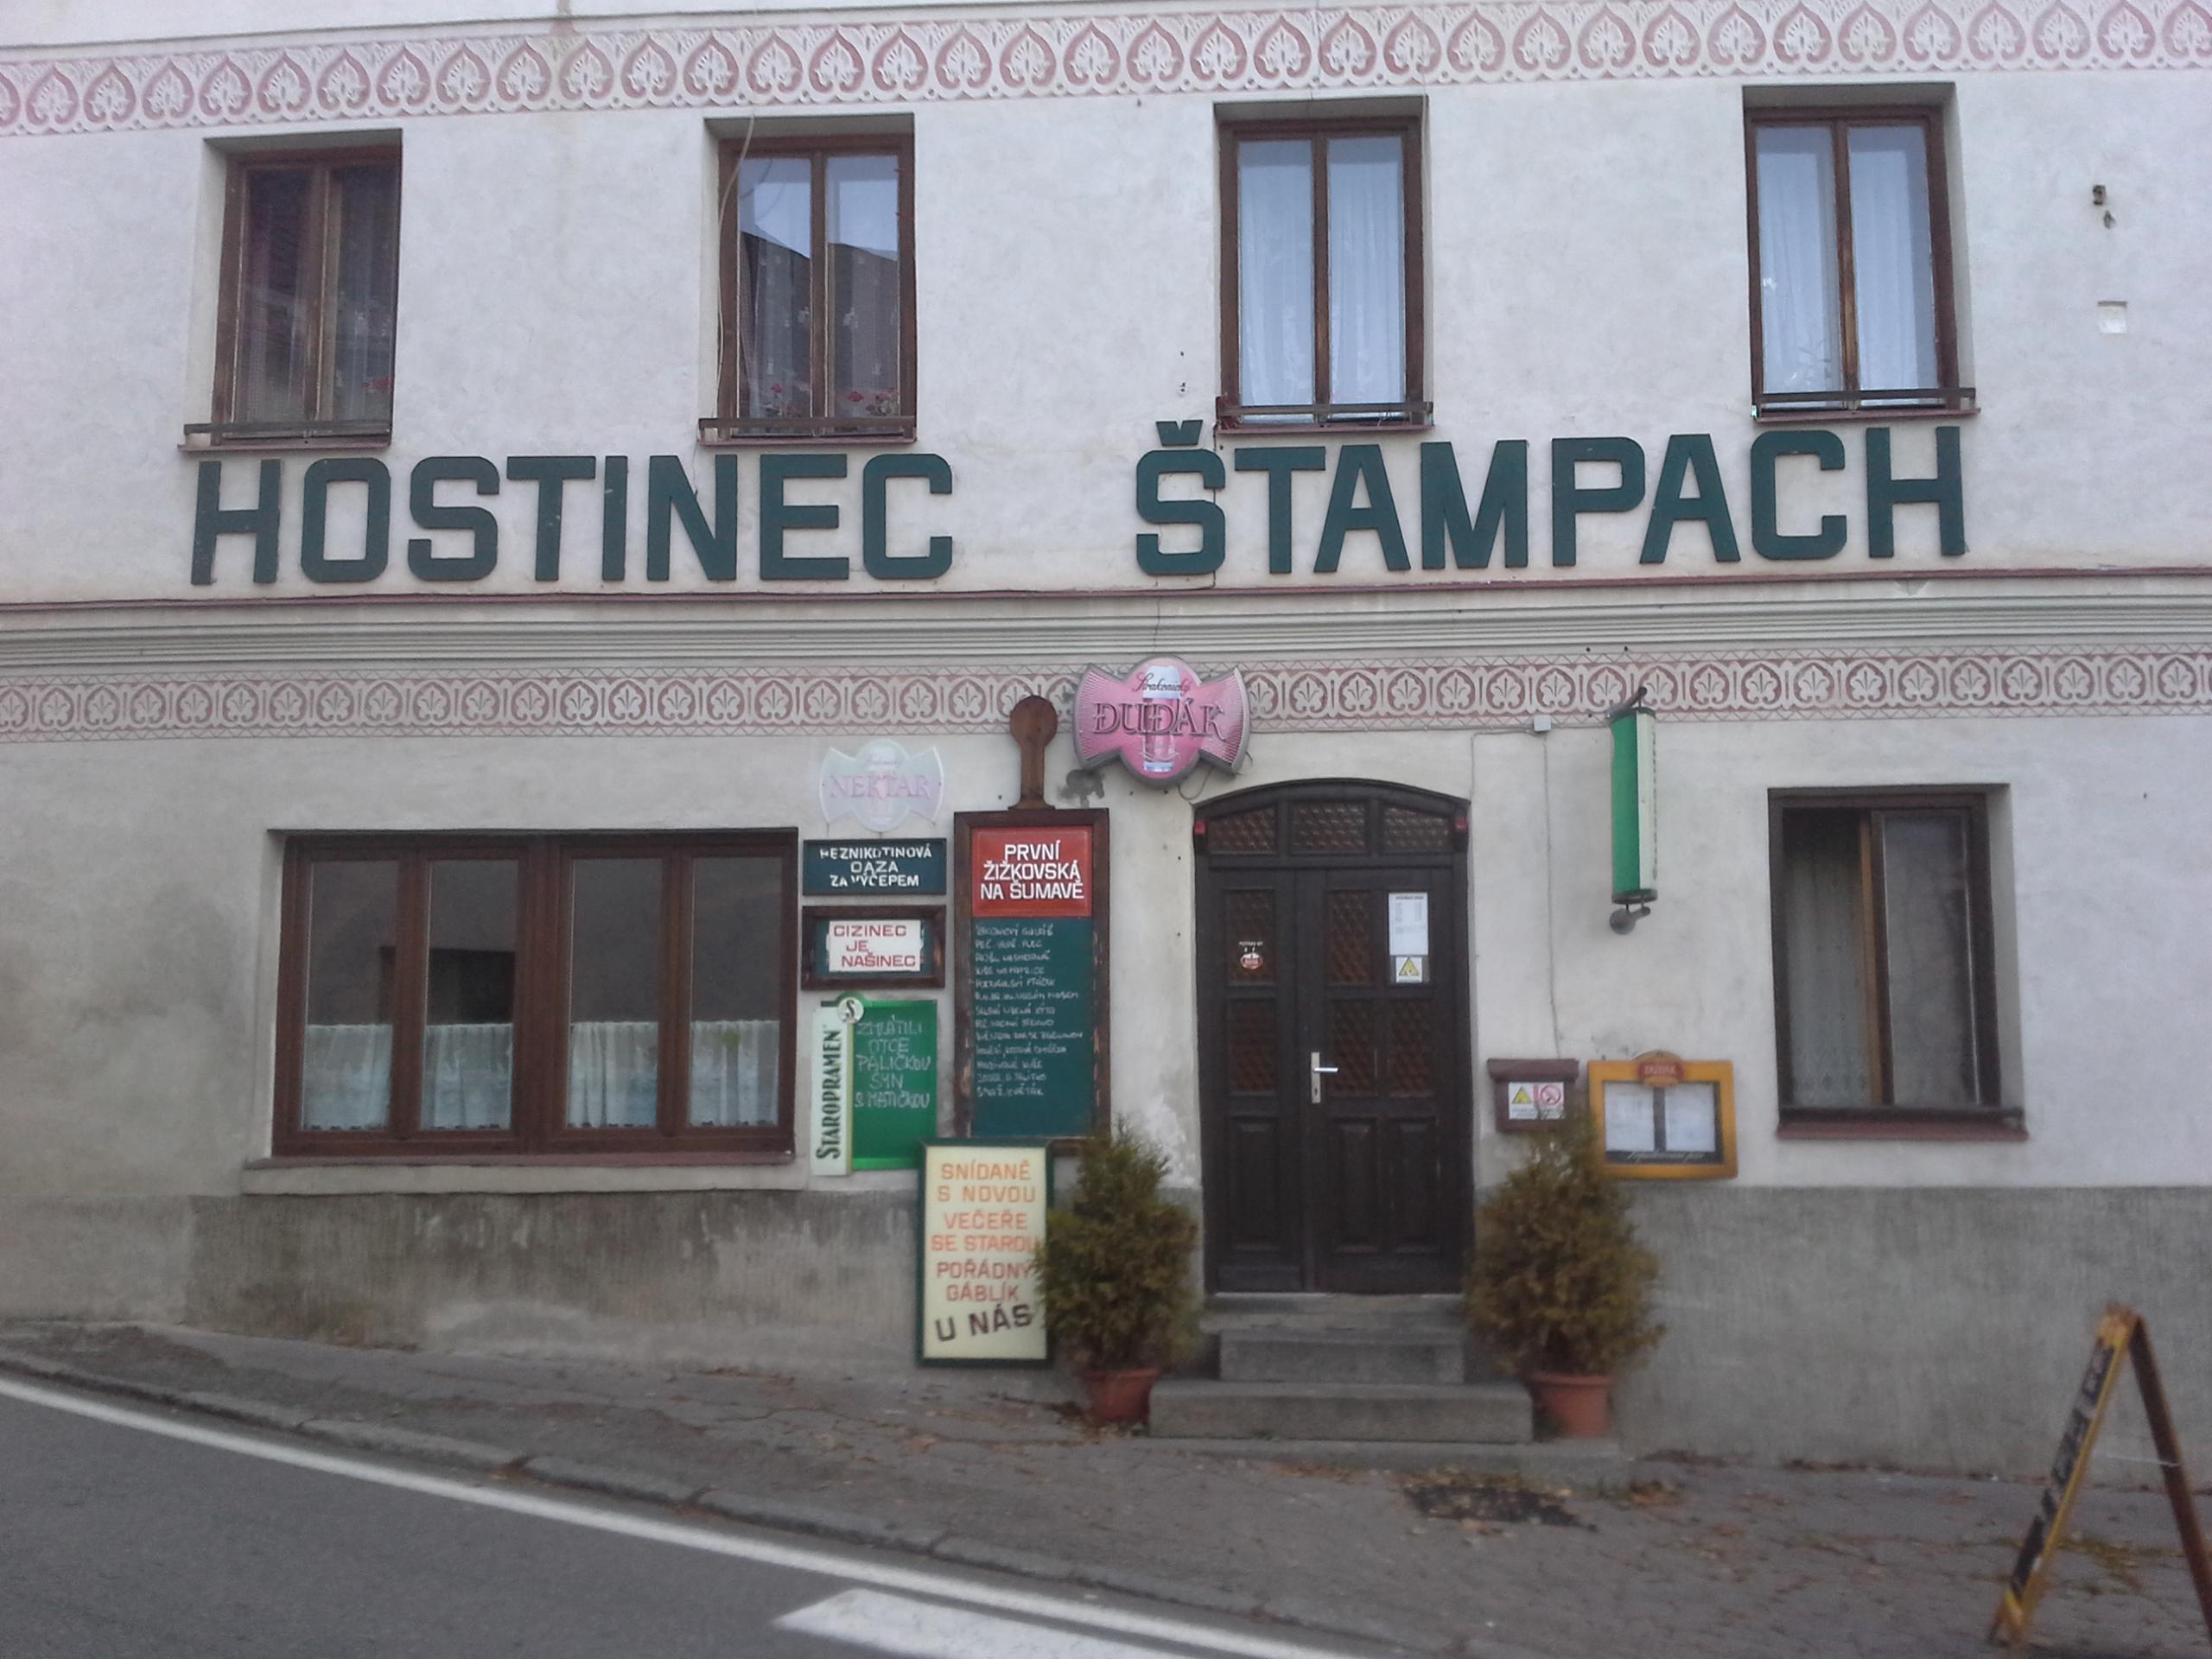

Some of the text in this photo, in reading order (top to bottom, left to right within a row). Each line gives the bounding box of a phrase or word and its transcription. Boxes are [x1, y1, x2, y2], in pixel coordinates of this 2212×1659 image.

[191, 420, 1966, 585] HOSTINEC ŠTAMPACH
[1092, 697, 1226, 742] DUDÁK
[1005, 840, 1061, 861] PRVNÍ
[983, 860, 1081, 880] ŽIŽKOVSKÁ
[830, 874, 848, 887] ZA
[981, 880, 1084, 899] NA ŠUMAVĚ
[834, 925, 906, 938] CIZINEC
[846, 940, 868, 952] JE
[842, 951, 916, 968] NAŠINEC
[868, 1037, 910, 1053] OTCE
[816, 1030, 842, 1160] STAROPRAMEN
[941, 1160, 1031, 1180] SNÍDANĚ
[938, 1185, 1035, 1203] S NOVOU
[944, 1209, 1028, 1230] VEČEŘE
[931, 1235, 1040, 1252] SE STAROU
[946, 1281, 1019, 1301] GÁBLÍK
[935, 1303, 1033, 1342] U NÁS
